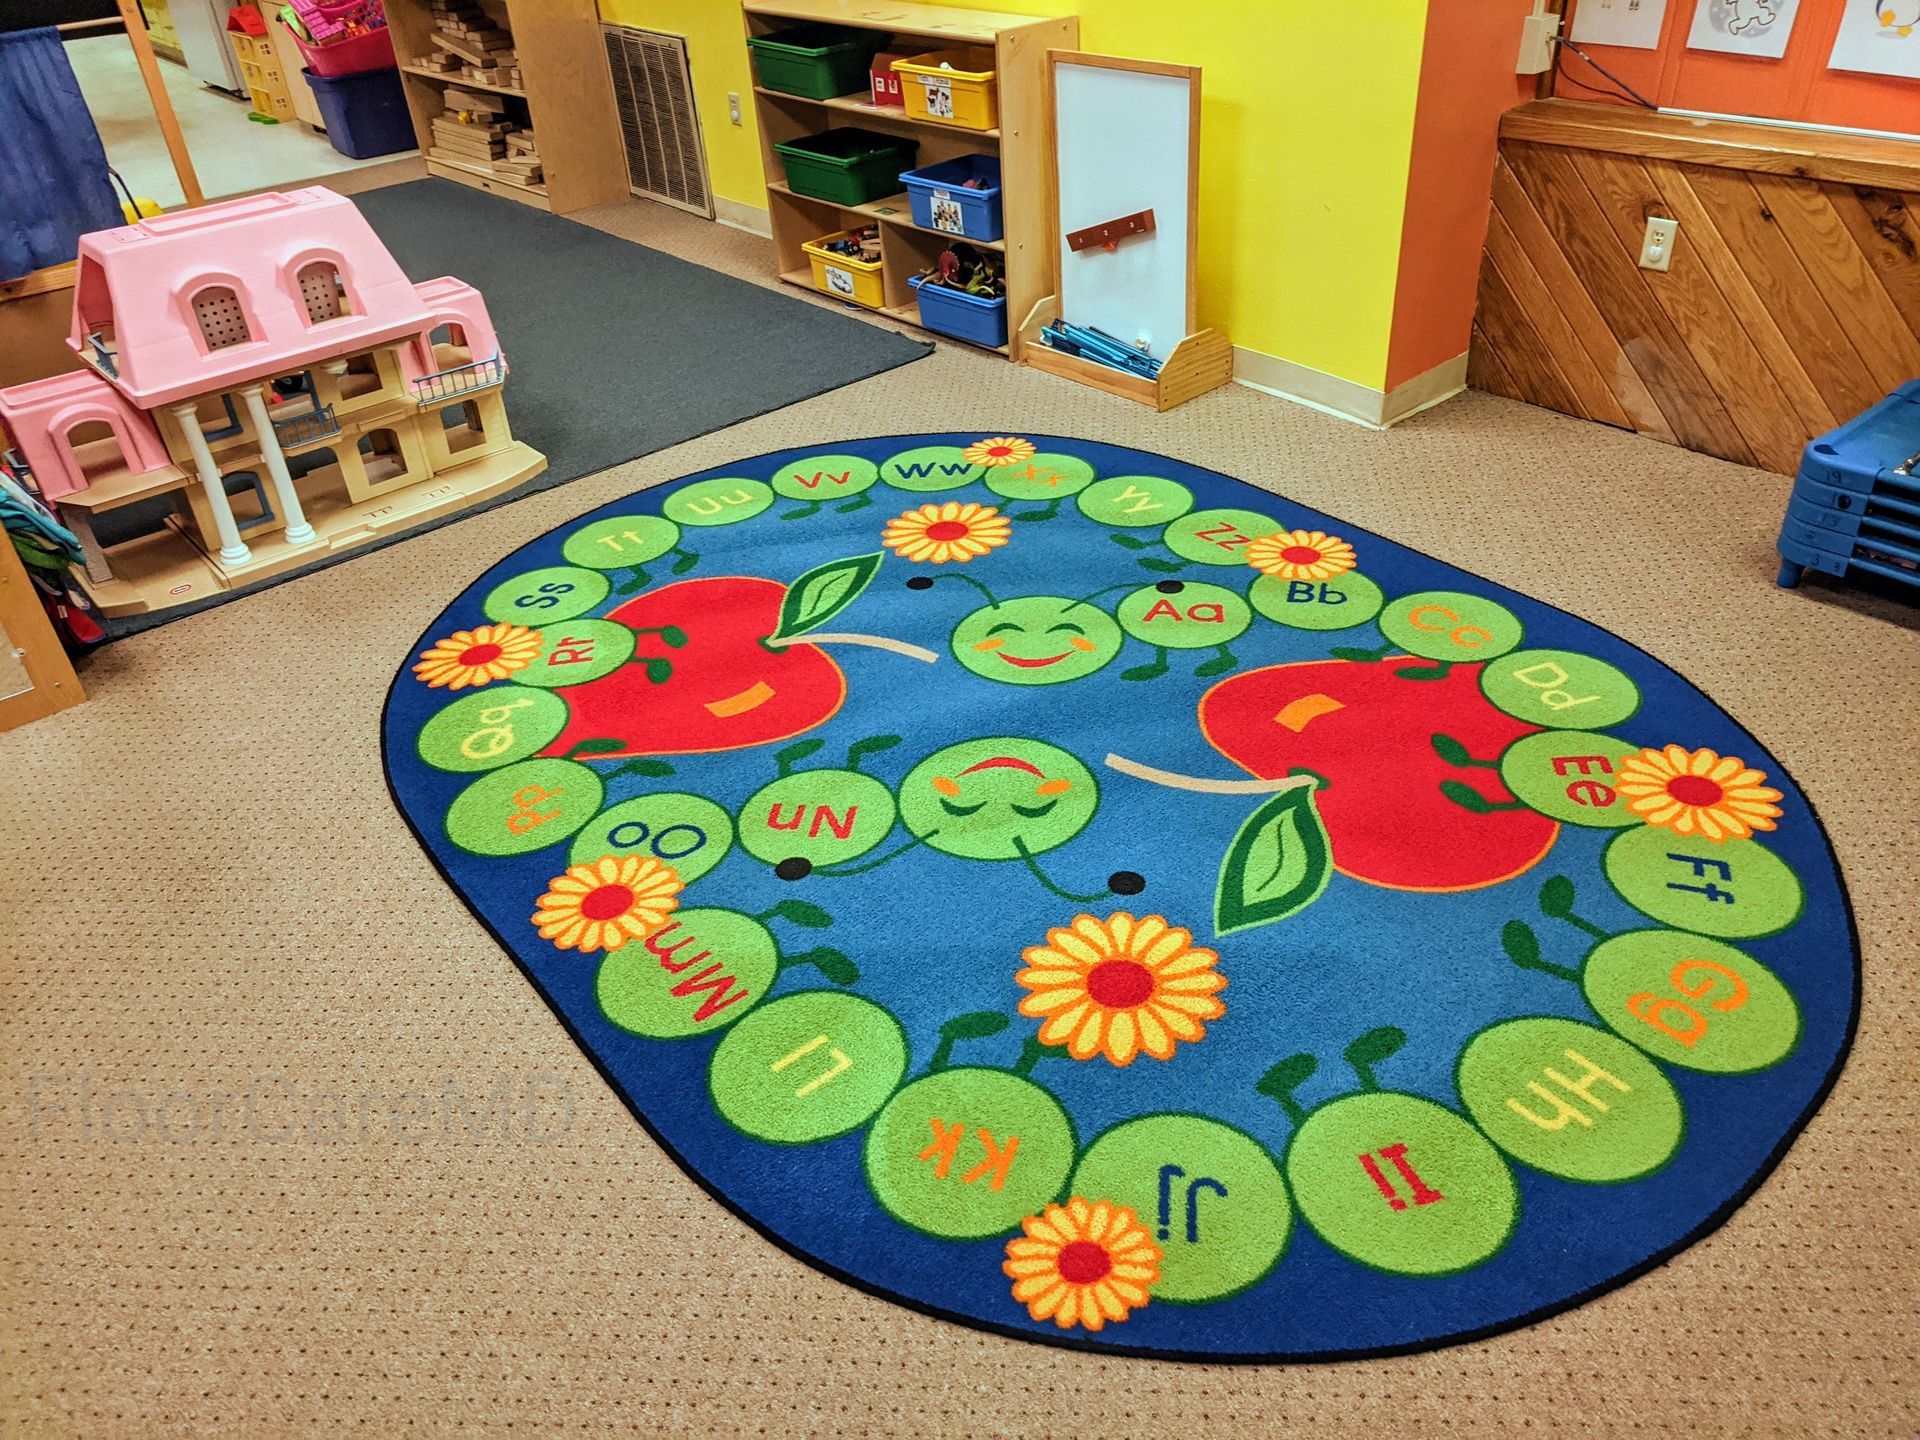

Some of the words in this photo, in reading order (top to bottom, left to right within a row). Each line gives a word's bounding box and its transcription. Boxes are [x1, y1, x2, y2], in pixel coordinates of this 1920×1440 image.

[794, 471, 851, 488] Vv
[895, 461, 973, 479] Ww
[687, 489, 753, 515] Uu
[1112, 485, 1163, 516] Yy
[597, 529, 644, 552] Tt
[1195, 522, 1251, 550] Zz
[514, 581, 574, 610] Ss
[1142, 599, 1224, 623] Aa
[1285, 580, 1348, 606] Bb
[1409, 605, 1493, 649] Cc
[548, 637, 595, 666] Rr
[1512, 662, 1600, 711] Dd
[460, 697, 533, 760] Qq
[1551, 754, 1617, 808] Ee
[506, 784, 564, 835] Pp
[767, 803, 857, 839] Nn
[608, 821, 707, 858] Oo
[1666, 852, 1735, 905] Ff
[643, 921, 749, 1023] Mm
[1626, 959, 1750, 1050] Gg
[771, 1034, 853, 1099] Ll
[1507, 1048, 1632, 1133] Hh
[918, 1117, 1020, 1191] Kk
[1359, 1143, 1445, 1212] Ii
[1157, 1164, 1228, 1243] Jj
